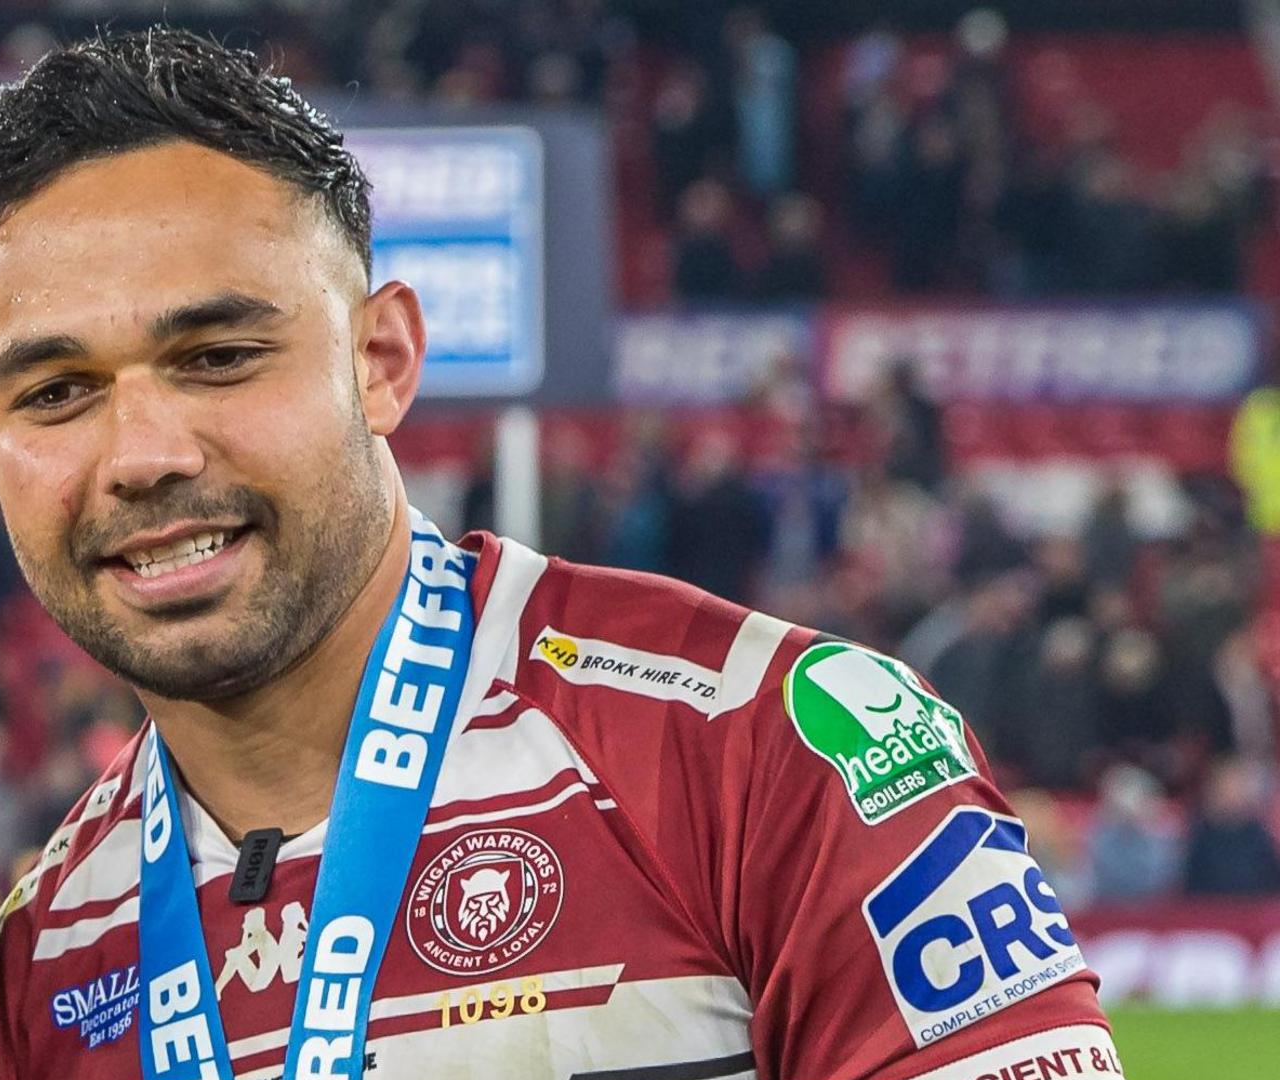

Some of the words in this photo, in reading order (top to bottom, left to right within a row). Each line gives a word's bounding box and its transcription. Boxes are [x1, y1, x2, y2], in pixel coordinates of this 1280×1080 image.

[537, 635, 579, 667] KHD
[581, 655, 640, 677] BROKK
[639, 668, 681, 685] HIRE
[861, 770, 927, 814] BOILERS
[416, 847, 464, 901] WIGAN
[466, 834, 554, 878] WARRIORS
[542, 882, 558, 894] 72
[414, 907, 427, 918] 18
[423, 940, 483, 968] ANCIENT
[488, 953, 498, 964] &
[503, 920, 544, 958] LOYAL
[892, 866, 1076, 1014] CRS
[433, 976, 547, 1029] 1098
[920, 994, 1003, 1043] COMPLETE
[1005, 968, 1057, 999] ROOFING
[89, 1032, 109, 1049] Est
[108, 1014, 132, 1043] 1956
[1090, 1047, 1109, 1072] &
